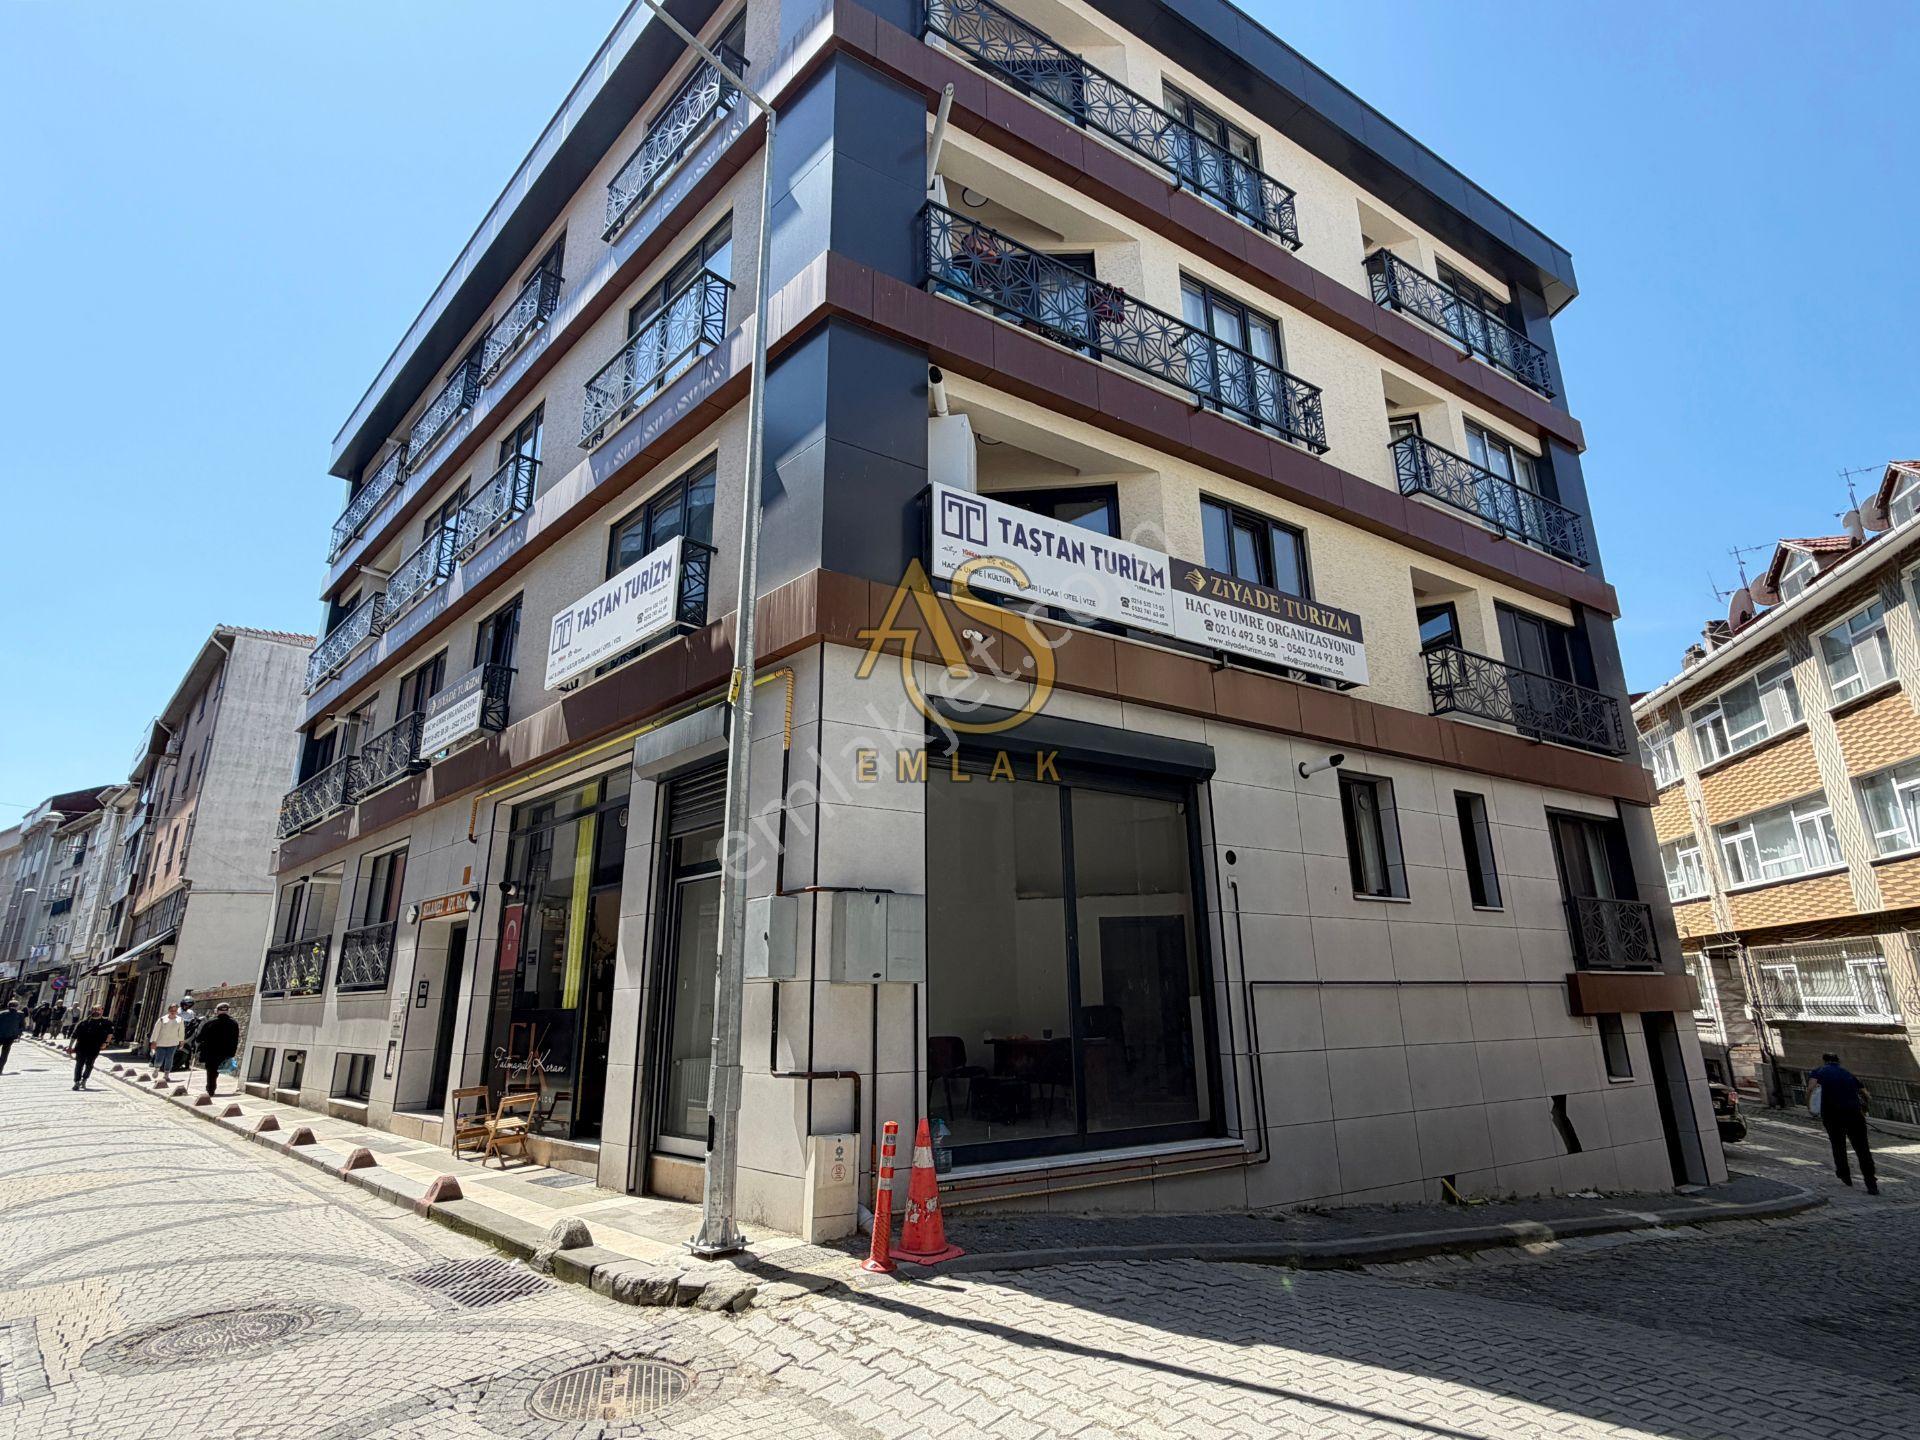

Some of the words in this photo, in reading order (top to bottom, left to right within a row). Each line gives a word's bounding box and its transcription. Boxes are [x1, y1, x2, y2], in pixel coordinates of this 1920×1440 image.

[998, 517, 1085, 567] TAŞTAN
[1090, 545, 1165, 589] TURİZM
[577, 586, 621, 632] TAŞTAN
[625, 554, 672, 604] TURİZM
[1042, 587, 1059, 598] UÇAK
[1064, 593, 1079, 602] OTEL
[1185, 598, 1211, 615] HAC
[1214, 607, 1226, 620] ve
[1230, 610, 1264, 631] UMRE
[1267, 621, 1355, 655] ORGANİZASYONU
[1208, 636, 1276, 658] www.ziyadeturizm.com
[1216, 623, 1236, 637] 0216
[1239, 630, 1254, 642] 492
[1257, 634, 1266, 645] 58
[1269, 638, 1278, 648] 58
[1287, 643, 1306, 656] 0542
[1308, 649, 1322, 660] 314
[1324, 653, 1333, 663] 92
[1335, 656, 1344, 666] 88
